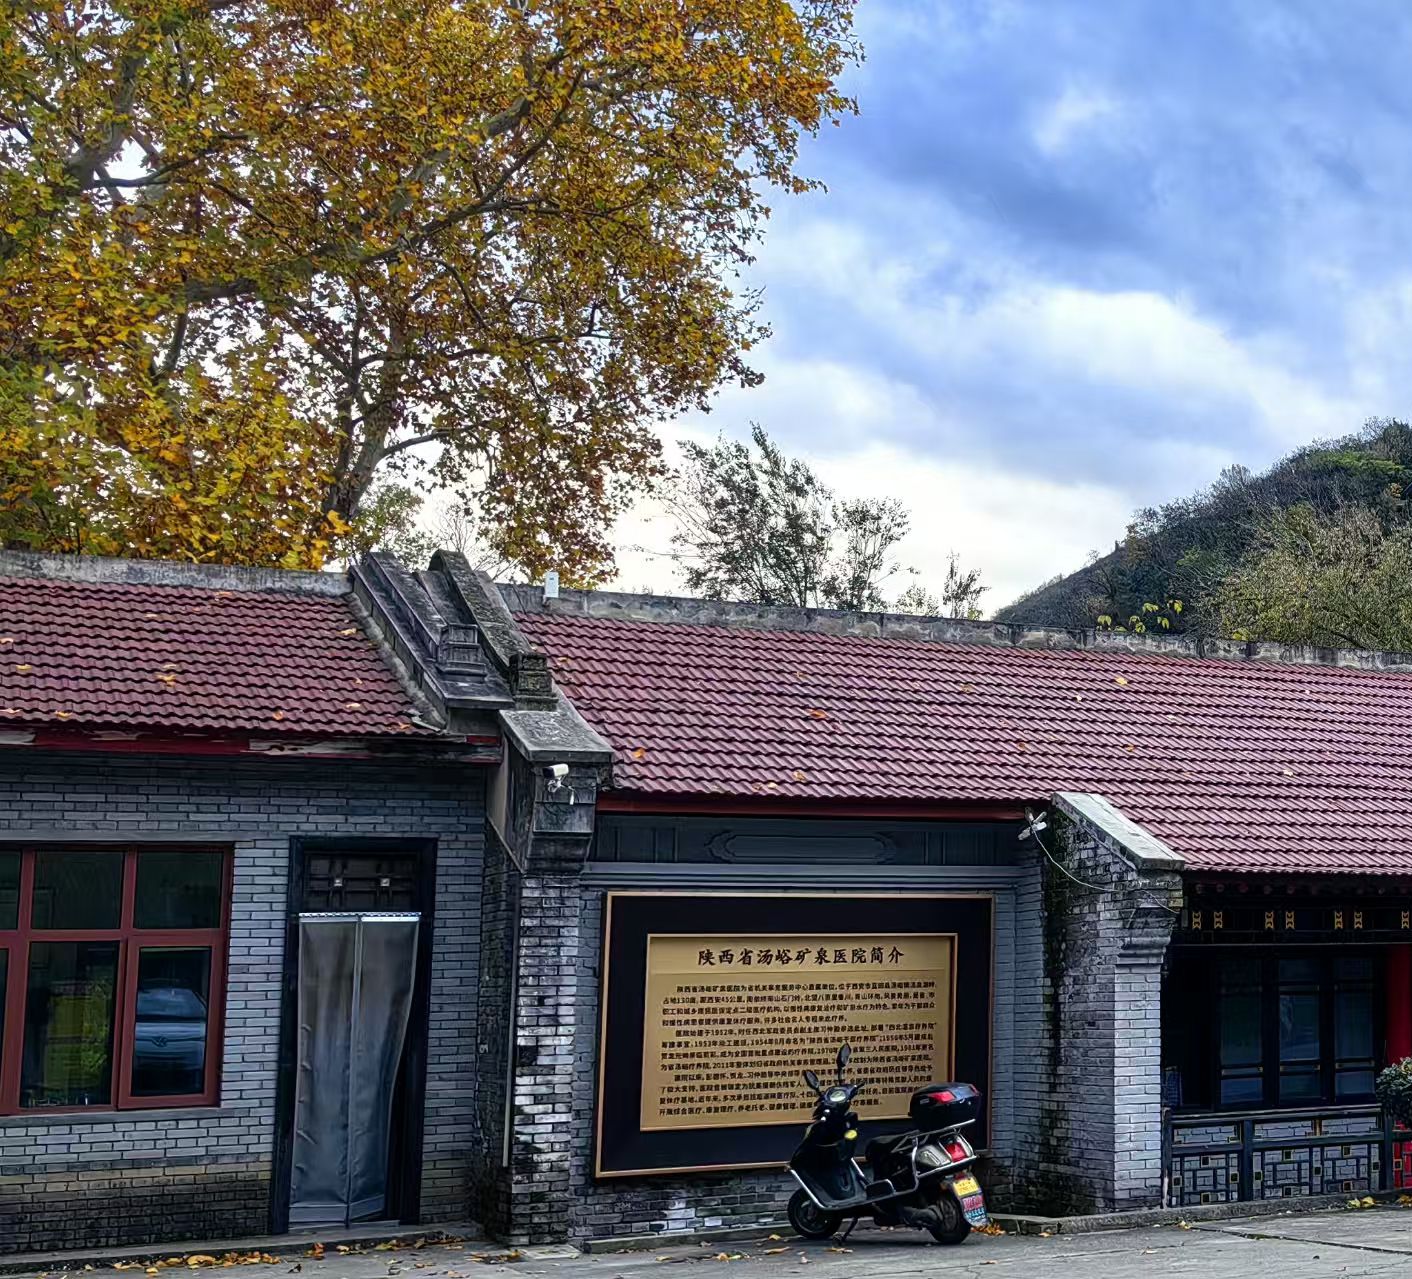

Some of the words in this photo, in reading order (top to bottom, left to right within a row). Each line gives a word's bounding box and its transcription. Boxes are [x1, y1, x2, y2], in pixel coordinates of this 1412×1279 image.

[698, 947, 904, 966] 陕西省汤峪矿泉医院简介
